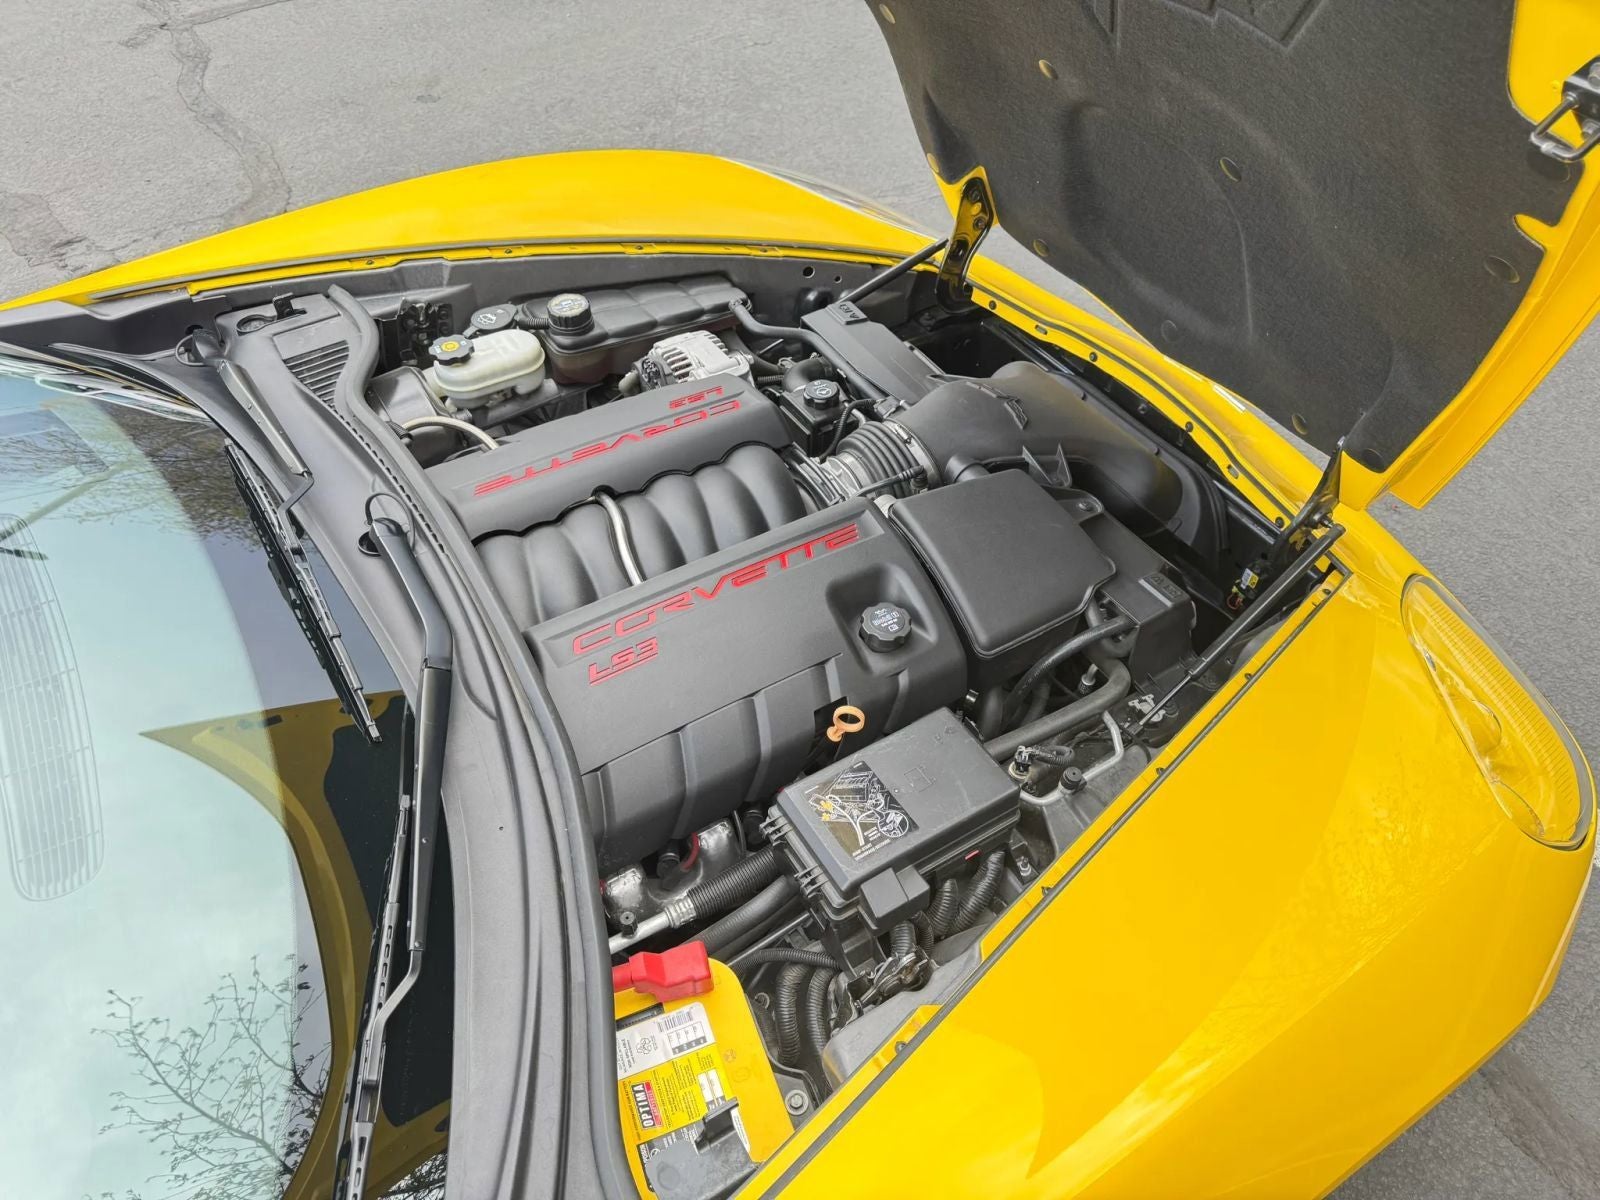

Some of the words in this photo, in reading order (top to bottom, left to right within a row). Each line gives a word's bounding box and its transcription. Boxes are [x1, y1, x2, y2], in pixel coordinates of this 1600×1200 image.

[669, 386, 723, 409] LS3
[474, 400, 741, 496] CORVETTE
[573, 524, 860, 655] CORVETTE
[588, 637, 659, 686] LS3
[632, 1083, 654, 1127] OPTIMA
